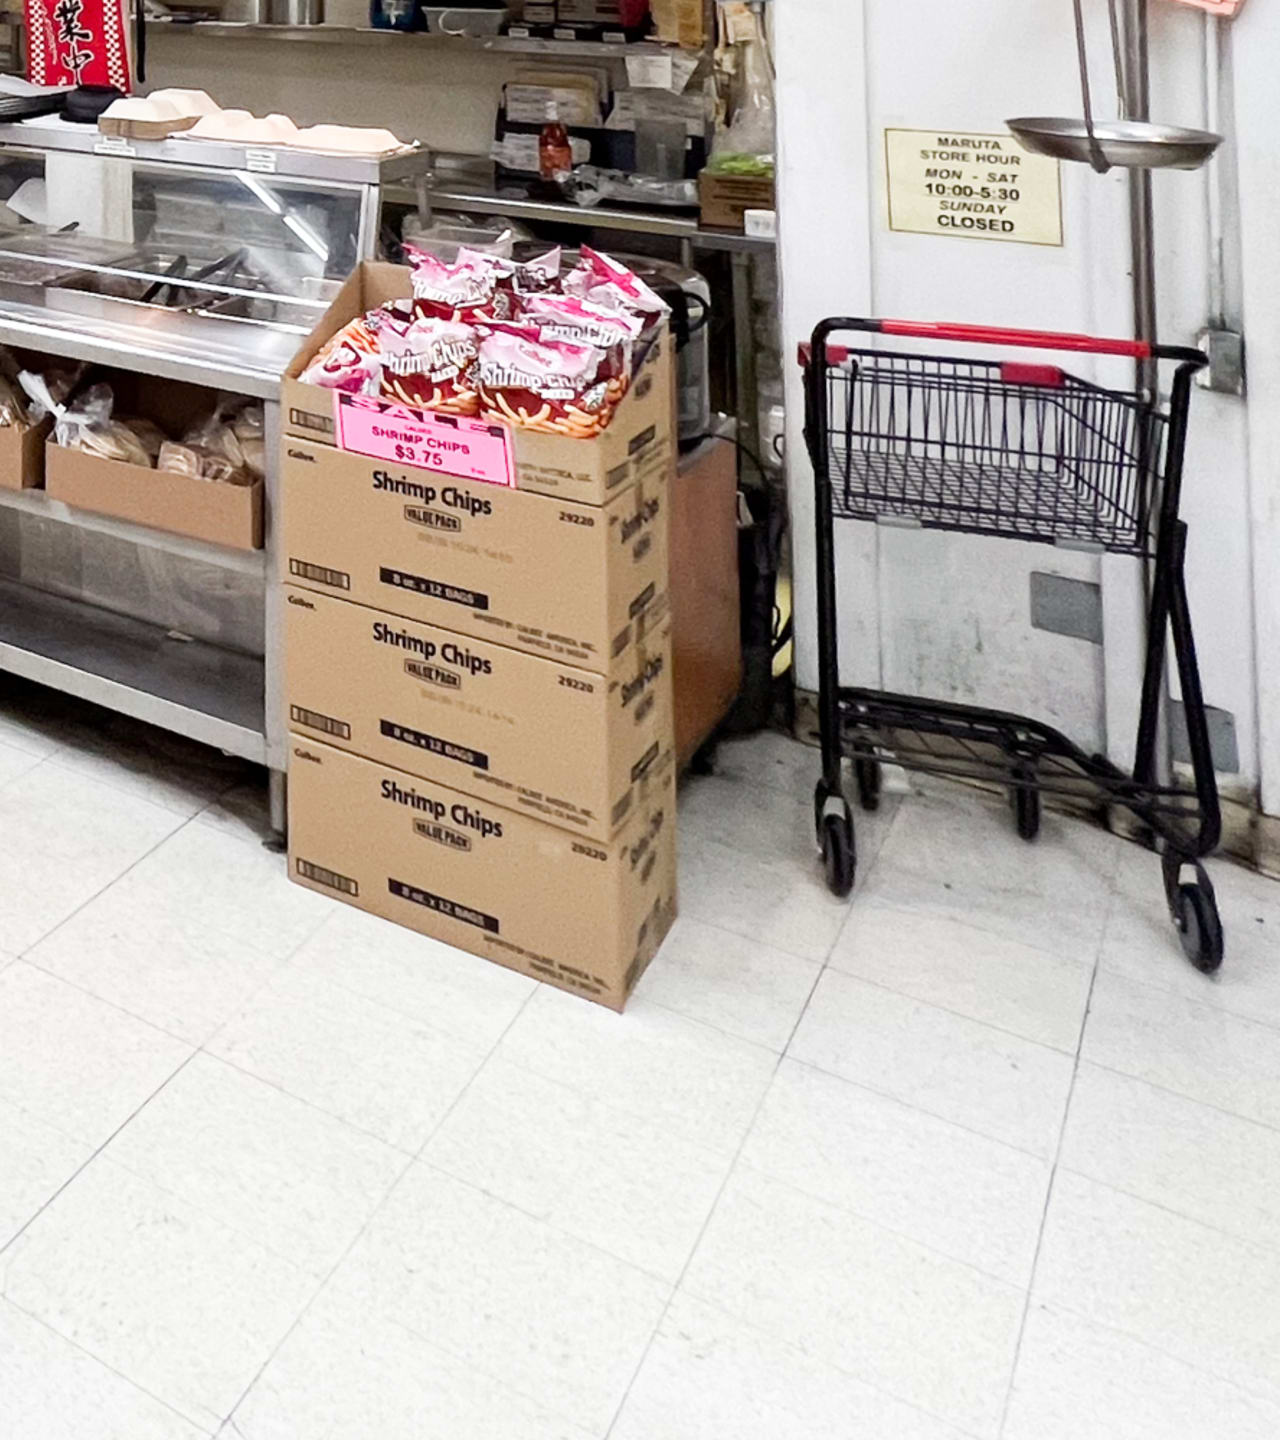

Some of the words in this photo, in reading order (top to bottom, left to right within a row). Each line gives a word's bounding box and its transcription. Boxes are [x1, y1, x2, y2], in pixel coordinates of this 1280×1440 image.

[937, 137, 1002, 151] MARUTA
[920, 150, 970, 163] STORE
[976, 153, 1021, 166] HOUR
[924, 168, 963, 180] MON
[987, 172, 1019, 184] SAT
[925, 183, 1020, 201] 10:00-5:30
[939, 200, 1007, 215] SUNDAY
[937, 214, 1015, 233] CLOSED
[483, 362, 544, 391] Shrimp
[371, 425, 423, 445] SHRIMP
[426, 437, 470, 455] CHIPS
[395, 444, 443, 466] $3.75
[372, 470, 437, 504] Shrimp
[441, 486, 492, 516] Chips
[406, 506, 434, 527] VALUE
[434, 512, 460, 532] PACK
[558, 511, 595, 528] 29220
[372, 622, 437, 658] Shrimp
[441, 643, 492, 675] Chips
[406, 660, 433, 681] VALUE
[434, 666, 460, 688] PACK
[558, 675, 594, 693] 29220
[380, 779, 445, 818] Shrimp
[450, 804, 504, 838] Chips
[415, 820, 443, 842] VALUE
[443, 828, 469, 849] PACK
